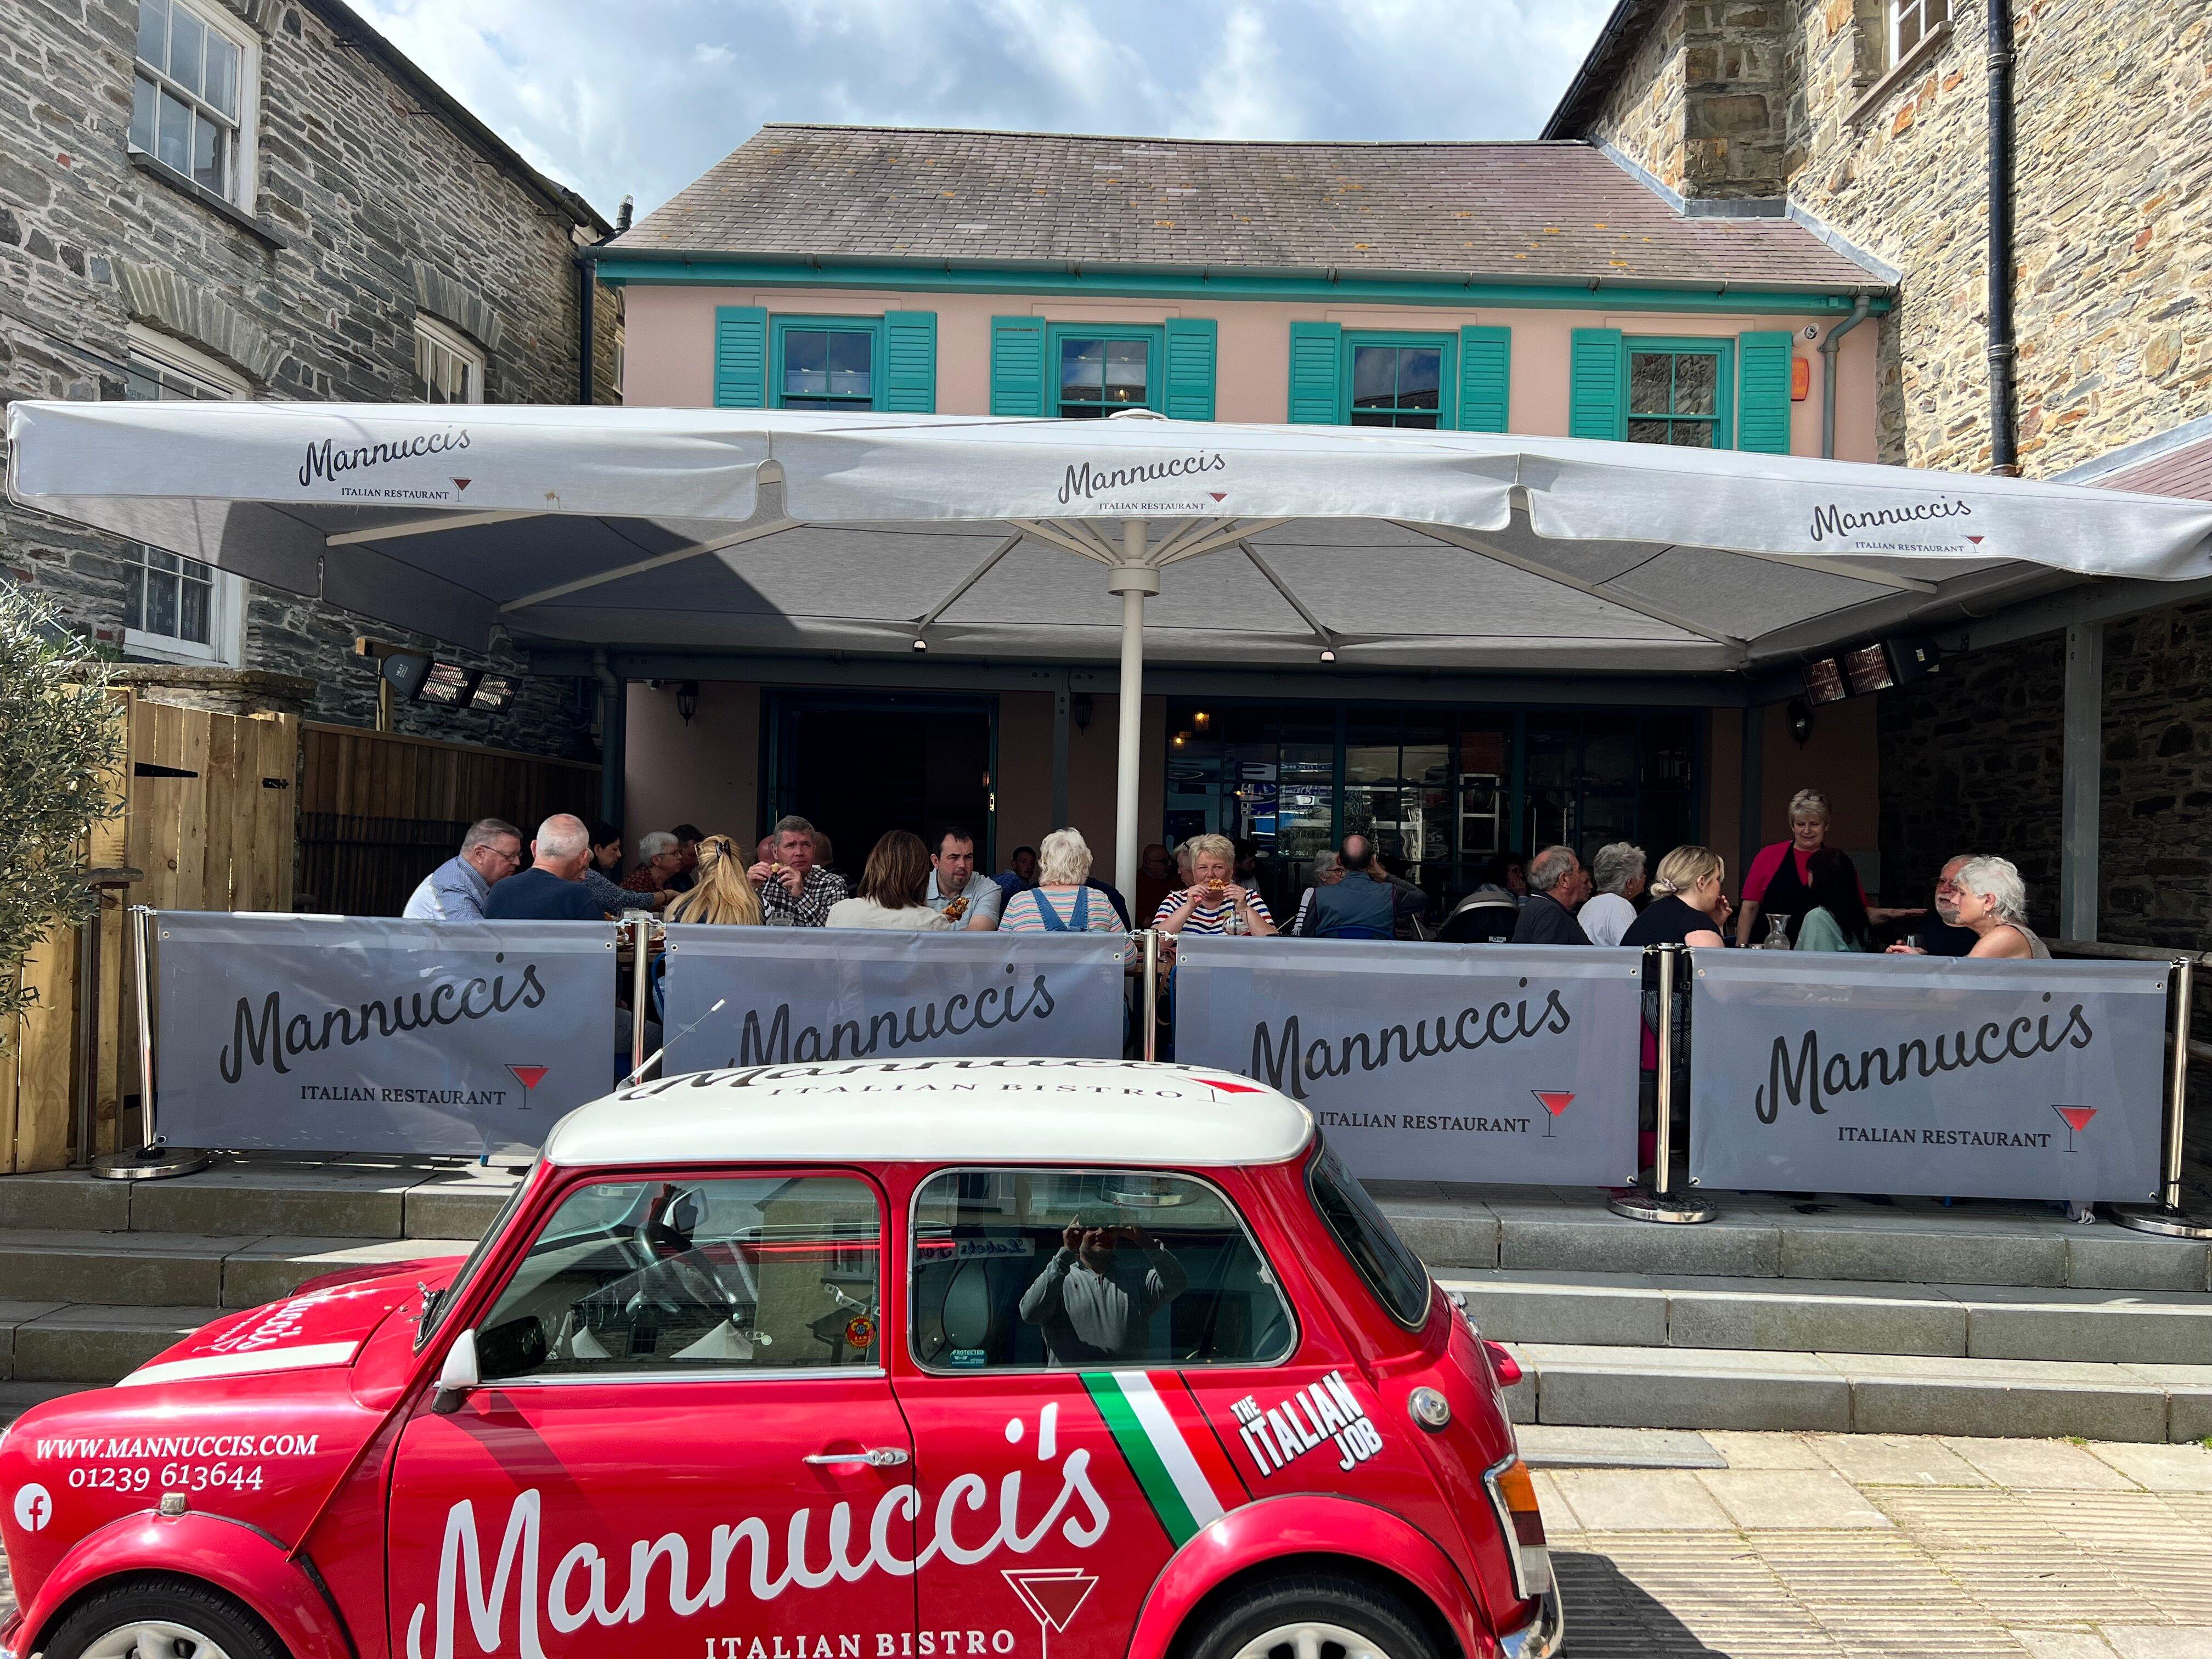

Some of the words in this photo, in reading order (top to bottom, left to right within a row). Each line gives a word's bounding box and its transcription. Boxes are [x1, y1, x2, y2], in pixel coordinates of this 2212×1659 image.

[299, 425, 471, 487] Mannuccis
[1058, 450, 1226, 504] Mannuccis
[341, 488, 381, 497] ITALIAN
[384, 489, 449, 499] RESTAURANT
[1810, 495, 1971, 541] Mannuccis
[1898, 544, 1965, 552] RESTAURANT
[220, 952, 545, 1084] Mannuccis
[1756, 992, 2092, 1124] Mannuccis
[301, 1086, 376, 1102] ITALIAN
[381, 1088, 506, 1105] RESTAURANT
[768, 1084, 979, 1096] ITALIAN
[1000, 1084, 1183, 1098] BISTRO
[1319, 1111, 1397, 1128] ITALIAN
[1402, 1115, 1530, 1133] RESTAURANT
[1838, 1127, 1916, 1144] ITALIAN
[1922, 1130, 2051, 1148] RESTAURANT
[1229, 1394, 1262, 1424] THE
[1238, 1369, 1365, 1478] ITALIAN
[36, 1434, 319, 1459] WWW.MANNUCCIS.COM
[1333, 1415, 1384, 1471] JOB
[68, 1466, 150, 1492] 01239
[160, 1462, 263, 1491] 613644
[406, 1402, 1110, 1659] Mannucci's
[706, 1634, 860, 1659] ITALIAN
[876, 1629, 1015, 1656] BISTRO
